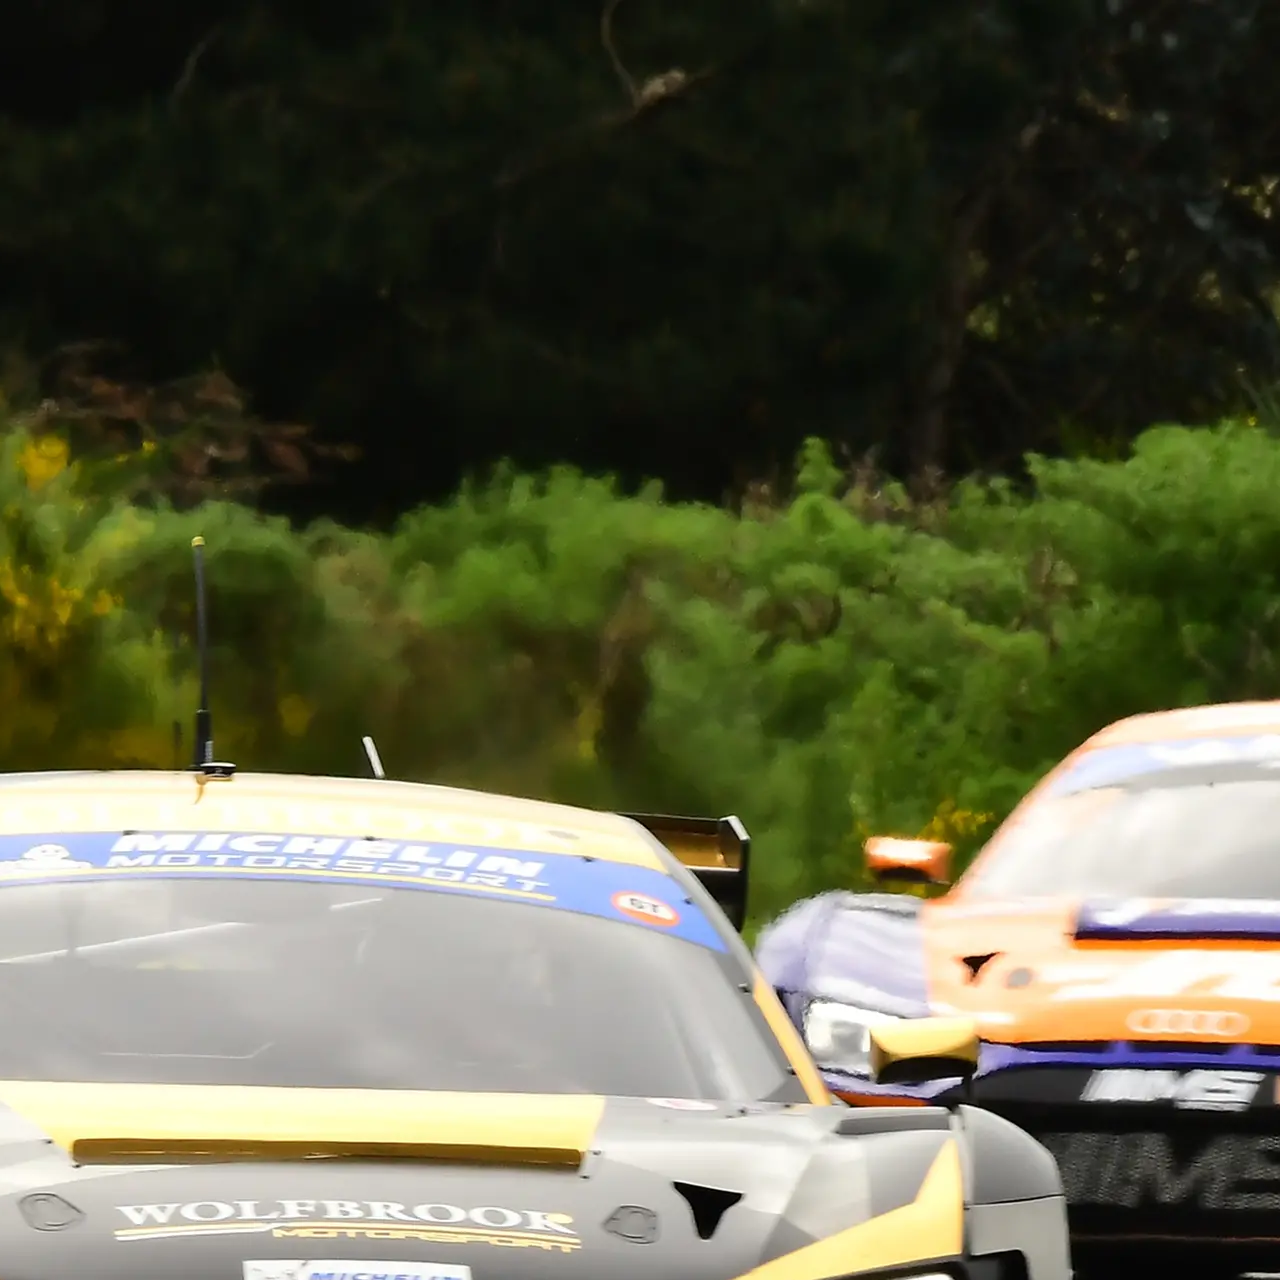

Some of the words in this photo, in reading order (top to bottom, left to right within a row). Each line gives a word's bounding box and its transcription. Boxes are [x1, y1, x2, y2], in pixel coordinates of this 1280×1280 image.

[106, 853, 550, 892] MOTORSPORT
[111, 834, 547, 877] MICHELIN
[115, 1200, 578, 1235] WOLFBROOK
